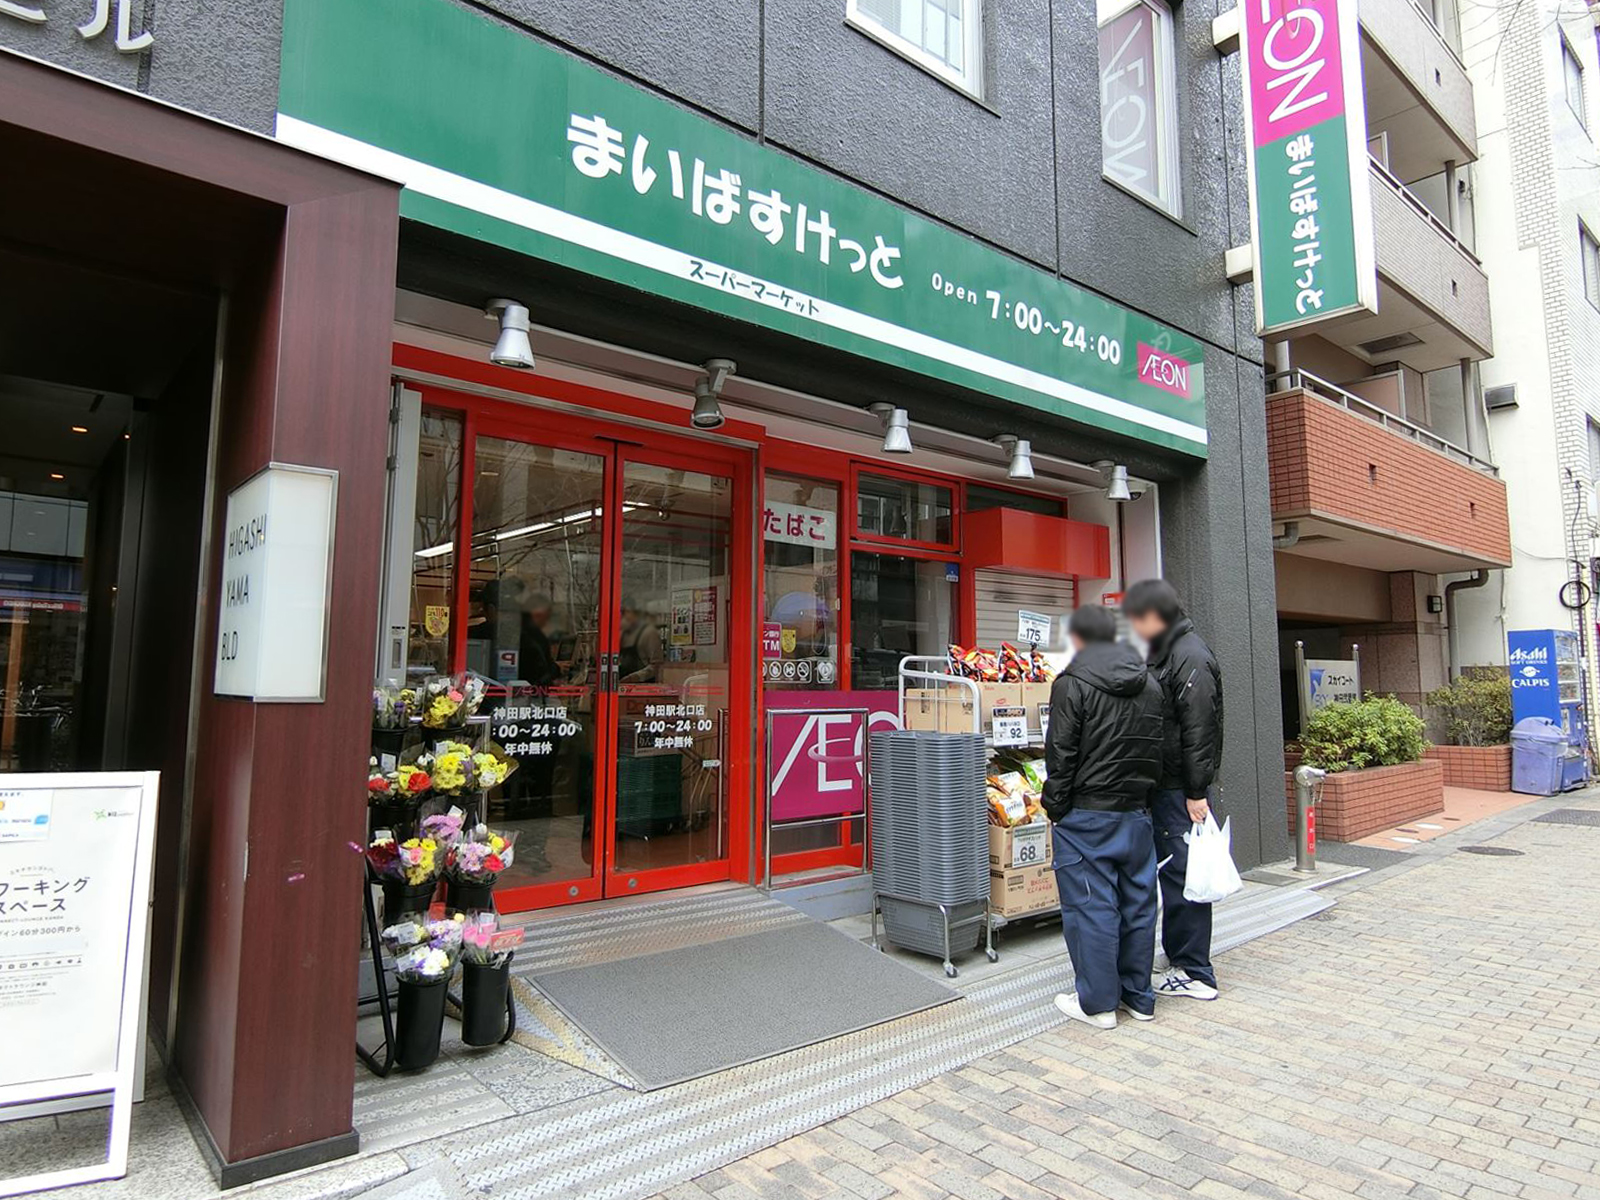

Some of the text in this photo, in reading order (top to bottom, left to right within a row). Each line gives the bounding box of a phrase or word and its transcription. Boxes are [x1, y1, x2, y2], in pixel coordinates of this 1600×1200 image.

[566, 112, 905, 289] まいばすけっと
[1284, 133, 1326, 316] まいばすけっと
[689, 259, 820, 316] スーパーマーケット
[931, 272, 978, 305] Open
[763, 508, 826, 541] たばこ
[228, 513, 267, 559] HIGASHI
[226, 573, 249, 609] YAMA
[1025, 628, 1041, 642] 175
[221, 630, 239, 661] BLD
[1510, 646, 1547, 660] Asahi
[1511, 677, 1550, 689] CALPIS
[493, 706, 568, 720] 神田駅北口店
[644, 704, 706, 718] 神田駅北口店
[491, 723, 577, 739] :00〜24:00
[1009, 727, 1022, 739] 92
[504, 741, 553, 756] 年中無休
[654, 735, 694, 750] 年中無休
[1019, 844, 1036, 862] 68
